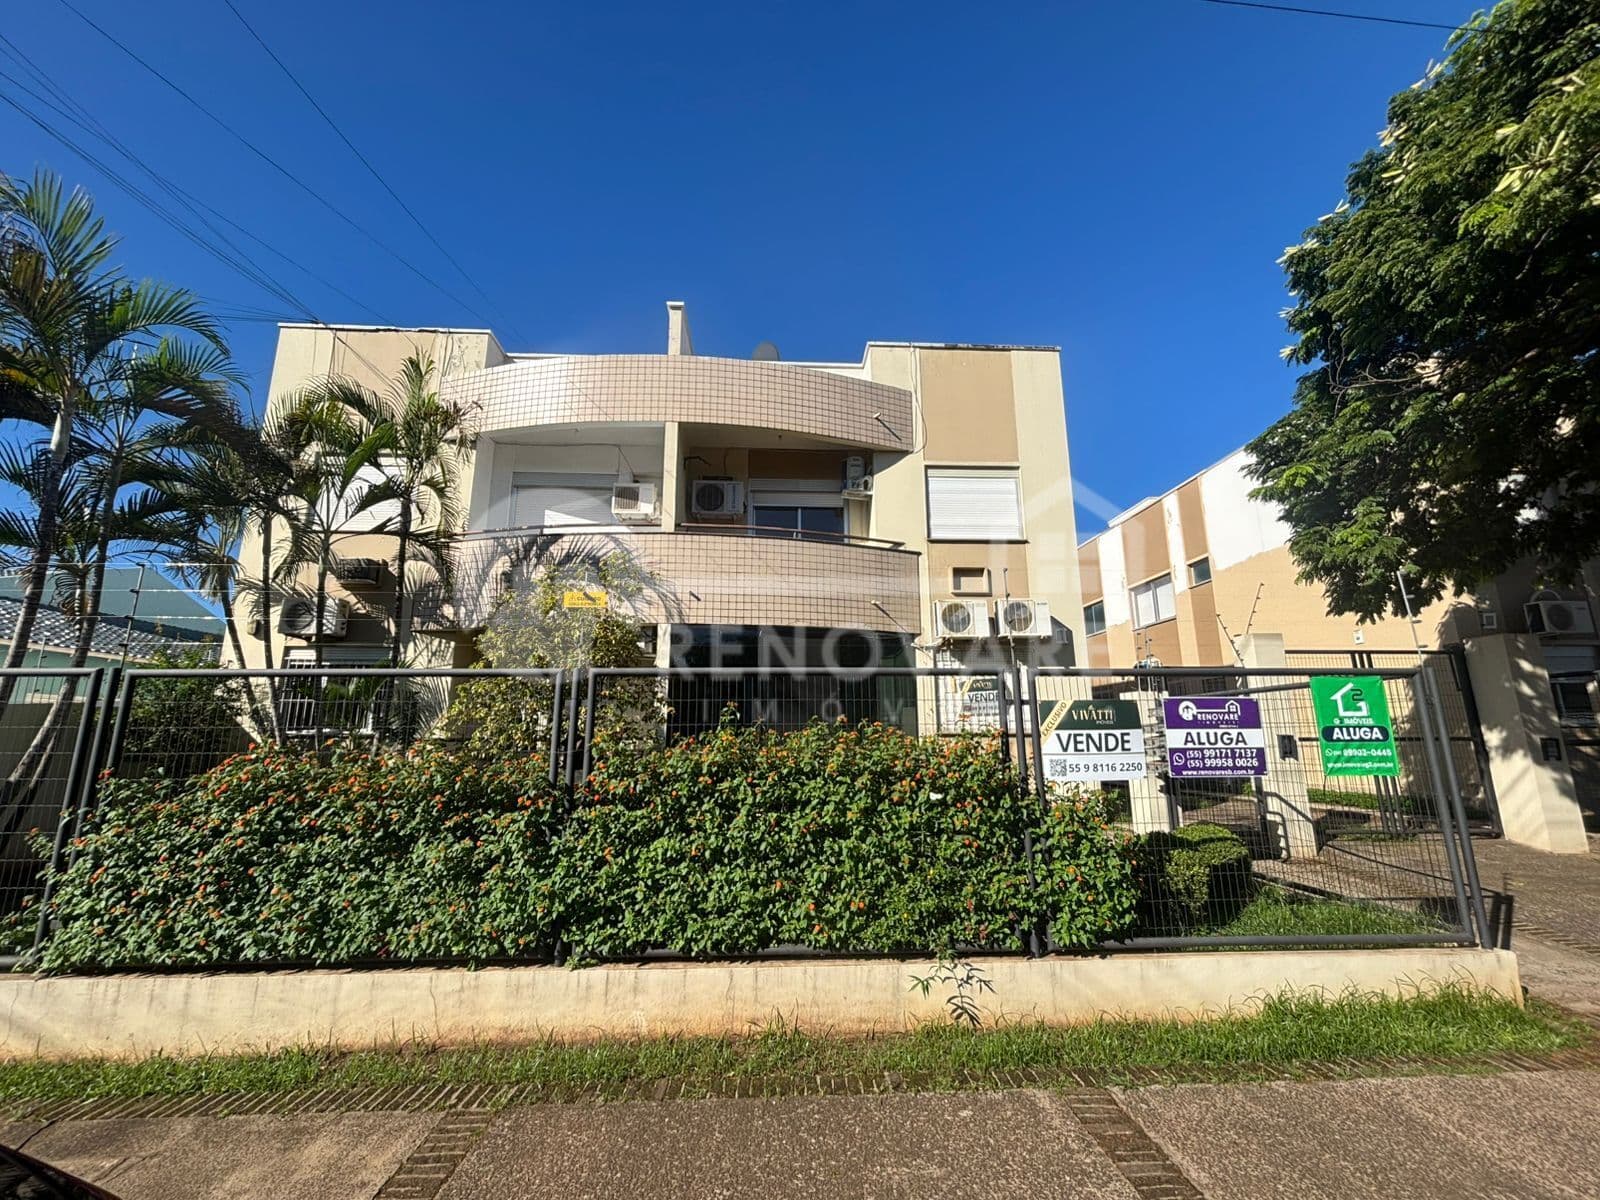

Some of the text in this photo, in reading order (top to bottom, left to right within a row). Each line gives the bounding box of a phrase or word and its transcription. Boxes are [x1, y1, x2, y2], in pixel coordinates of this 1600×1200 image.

[1041, 701, 1068, 737] EXCLUSIVO
[1071, 709, 1113, 720] VIVATTI
[1197, 713, 1239, 721] RENOVARE
[1184, 731, 1248, 746] ALUGA
[1332, 727, 1383, 740] ALUGA
[1056, 732, 1131, 752] VENDE
[1186, 748, 1257, 759] (55) 99171 7137
[1068, 761, 1143, 773] 55 9 8116 2250
[1187, 758, 1259, 768] (55) 99958 0026
